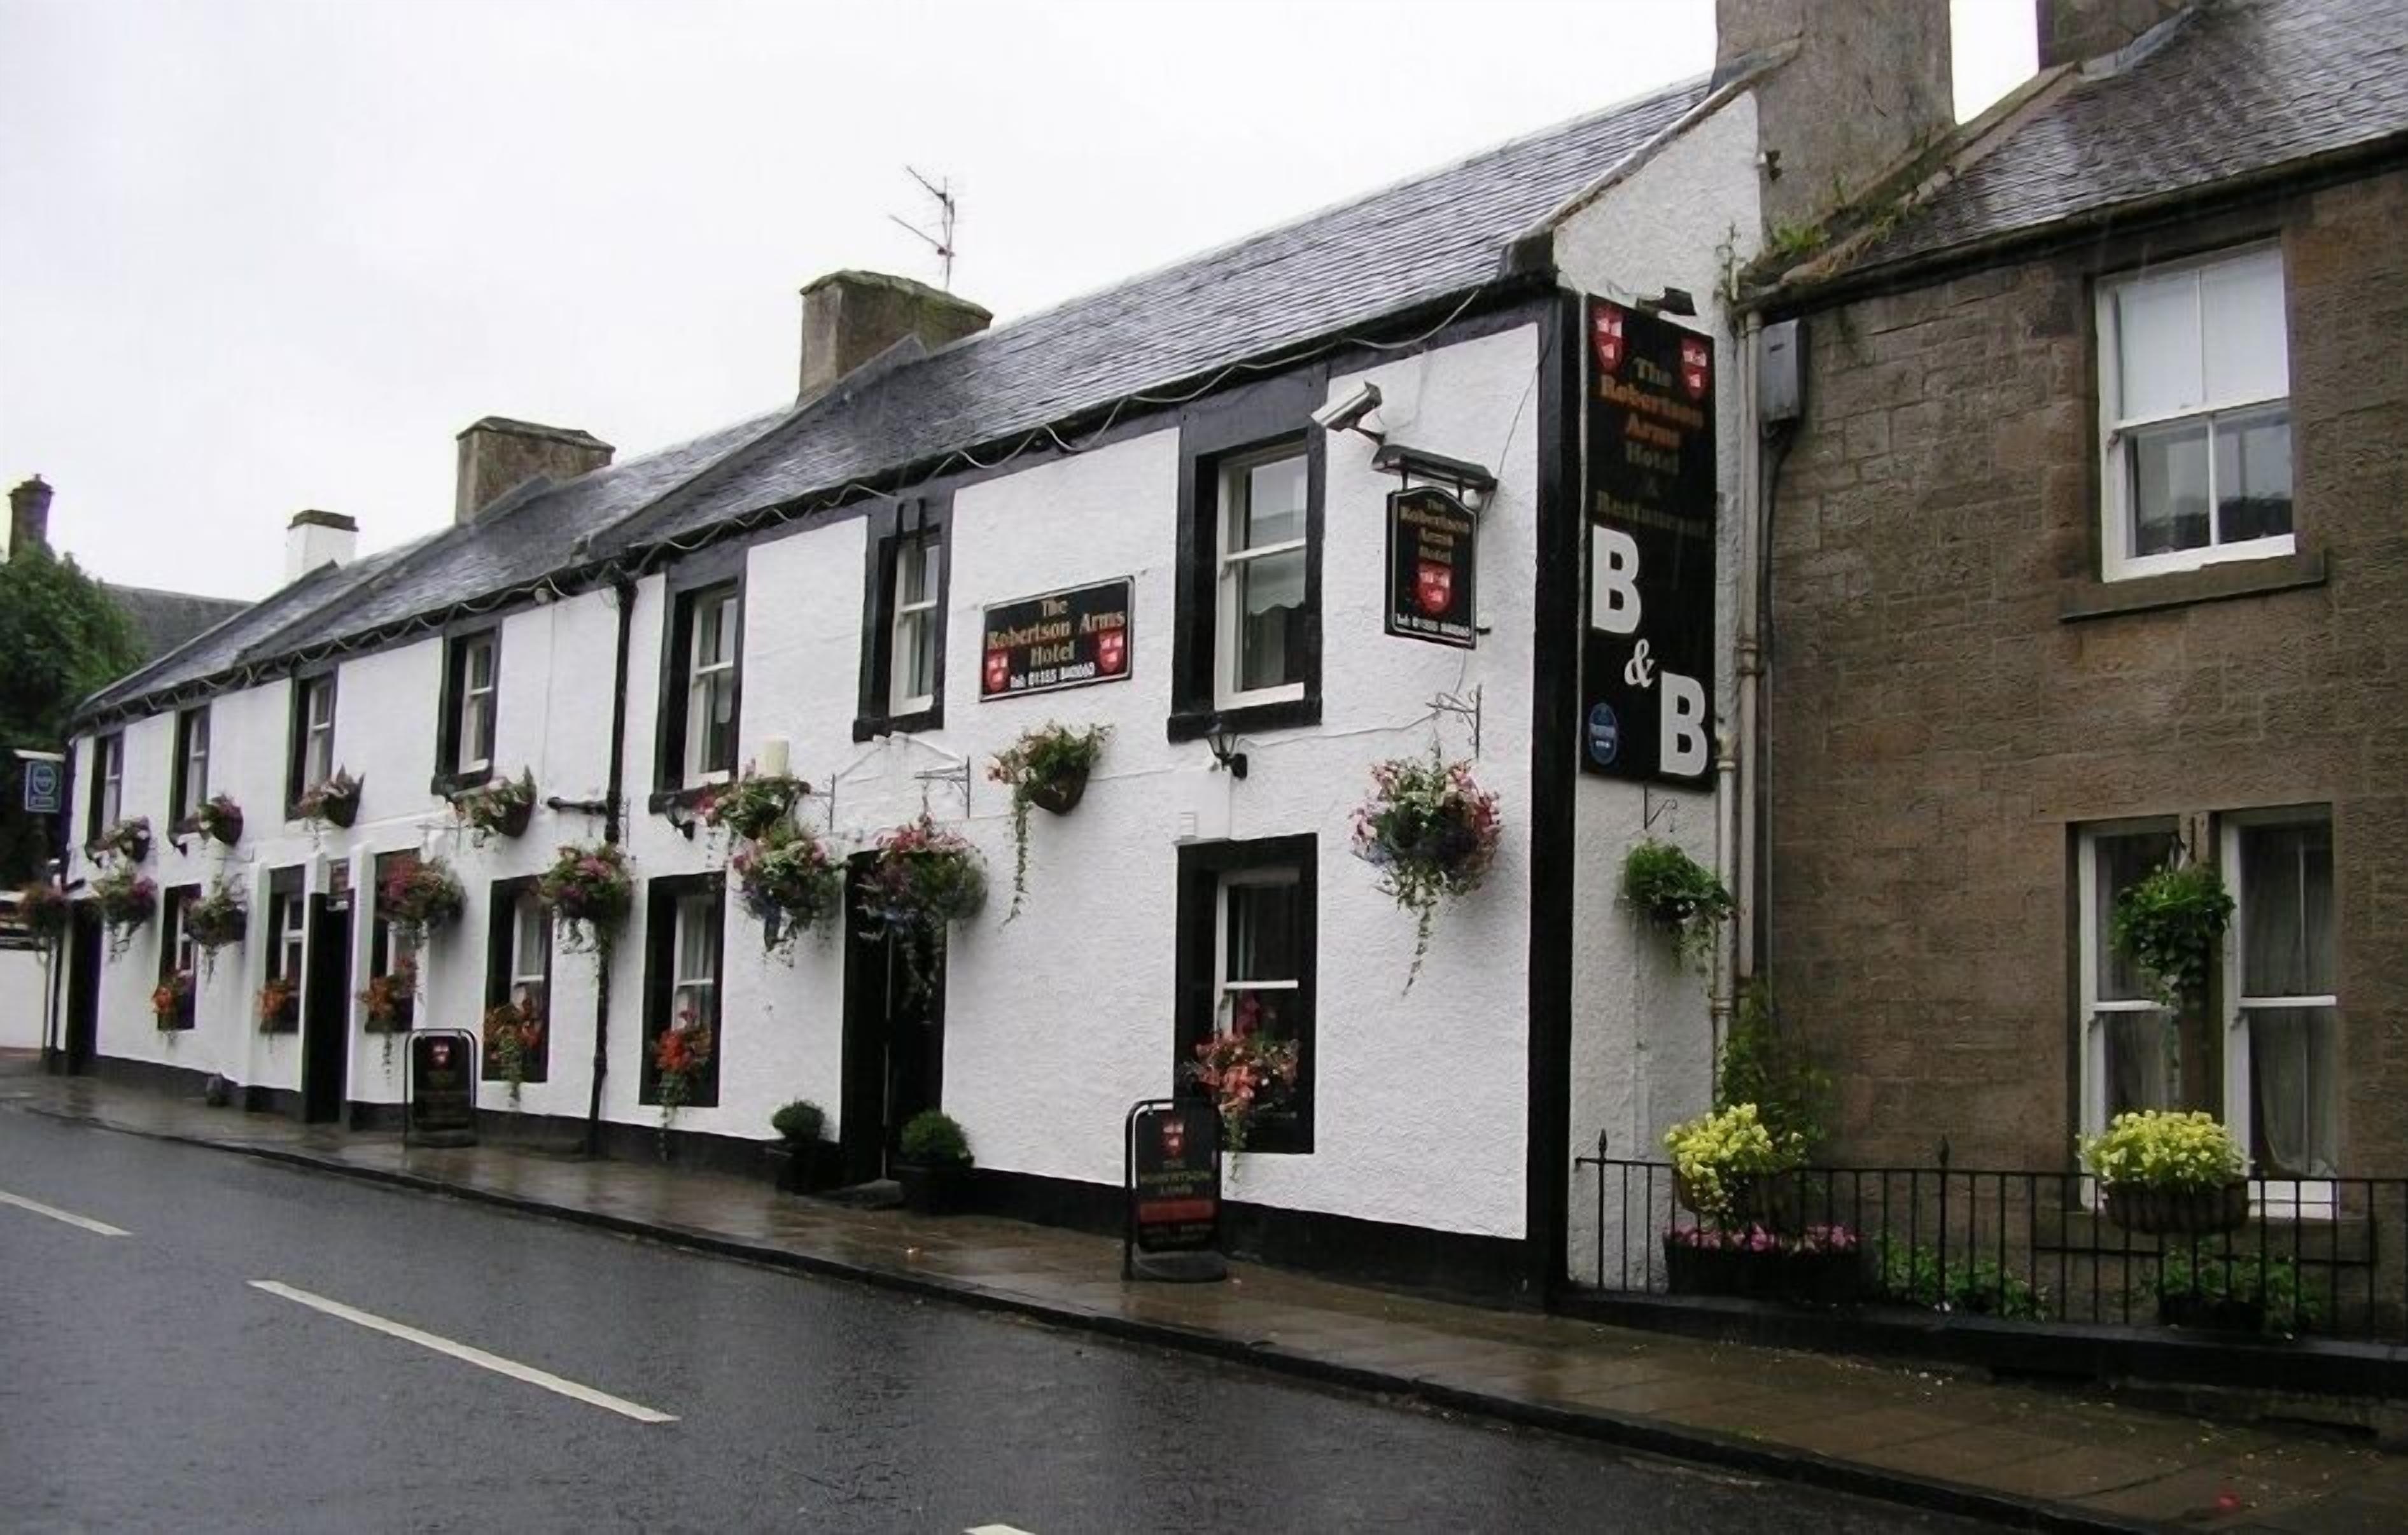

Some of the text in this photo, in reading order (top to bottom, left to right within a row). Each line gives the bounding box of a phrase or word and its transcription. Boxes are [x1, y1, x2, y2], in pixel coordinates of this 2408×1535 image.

[1041, 599, 1068, 617] The
[988, 611, 1125, 650] Robertson Arms
[1030, 640, 1075, 666] Hotel
[1593, 524, 1707, 776] B & B
